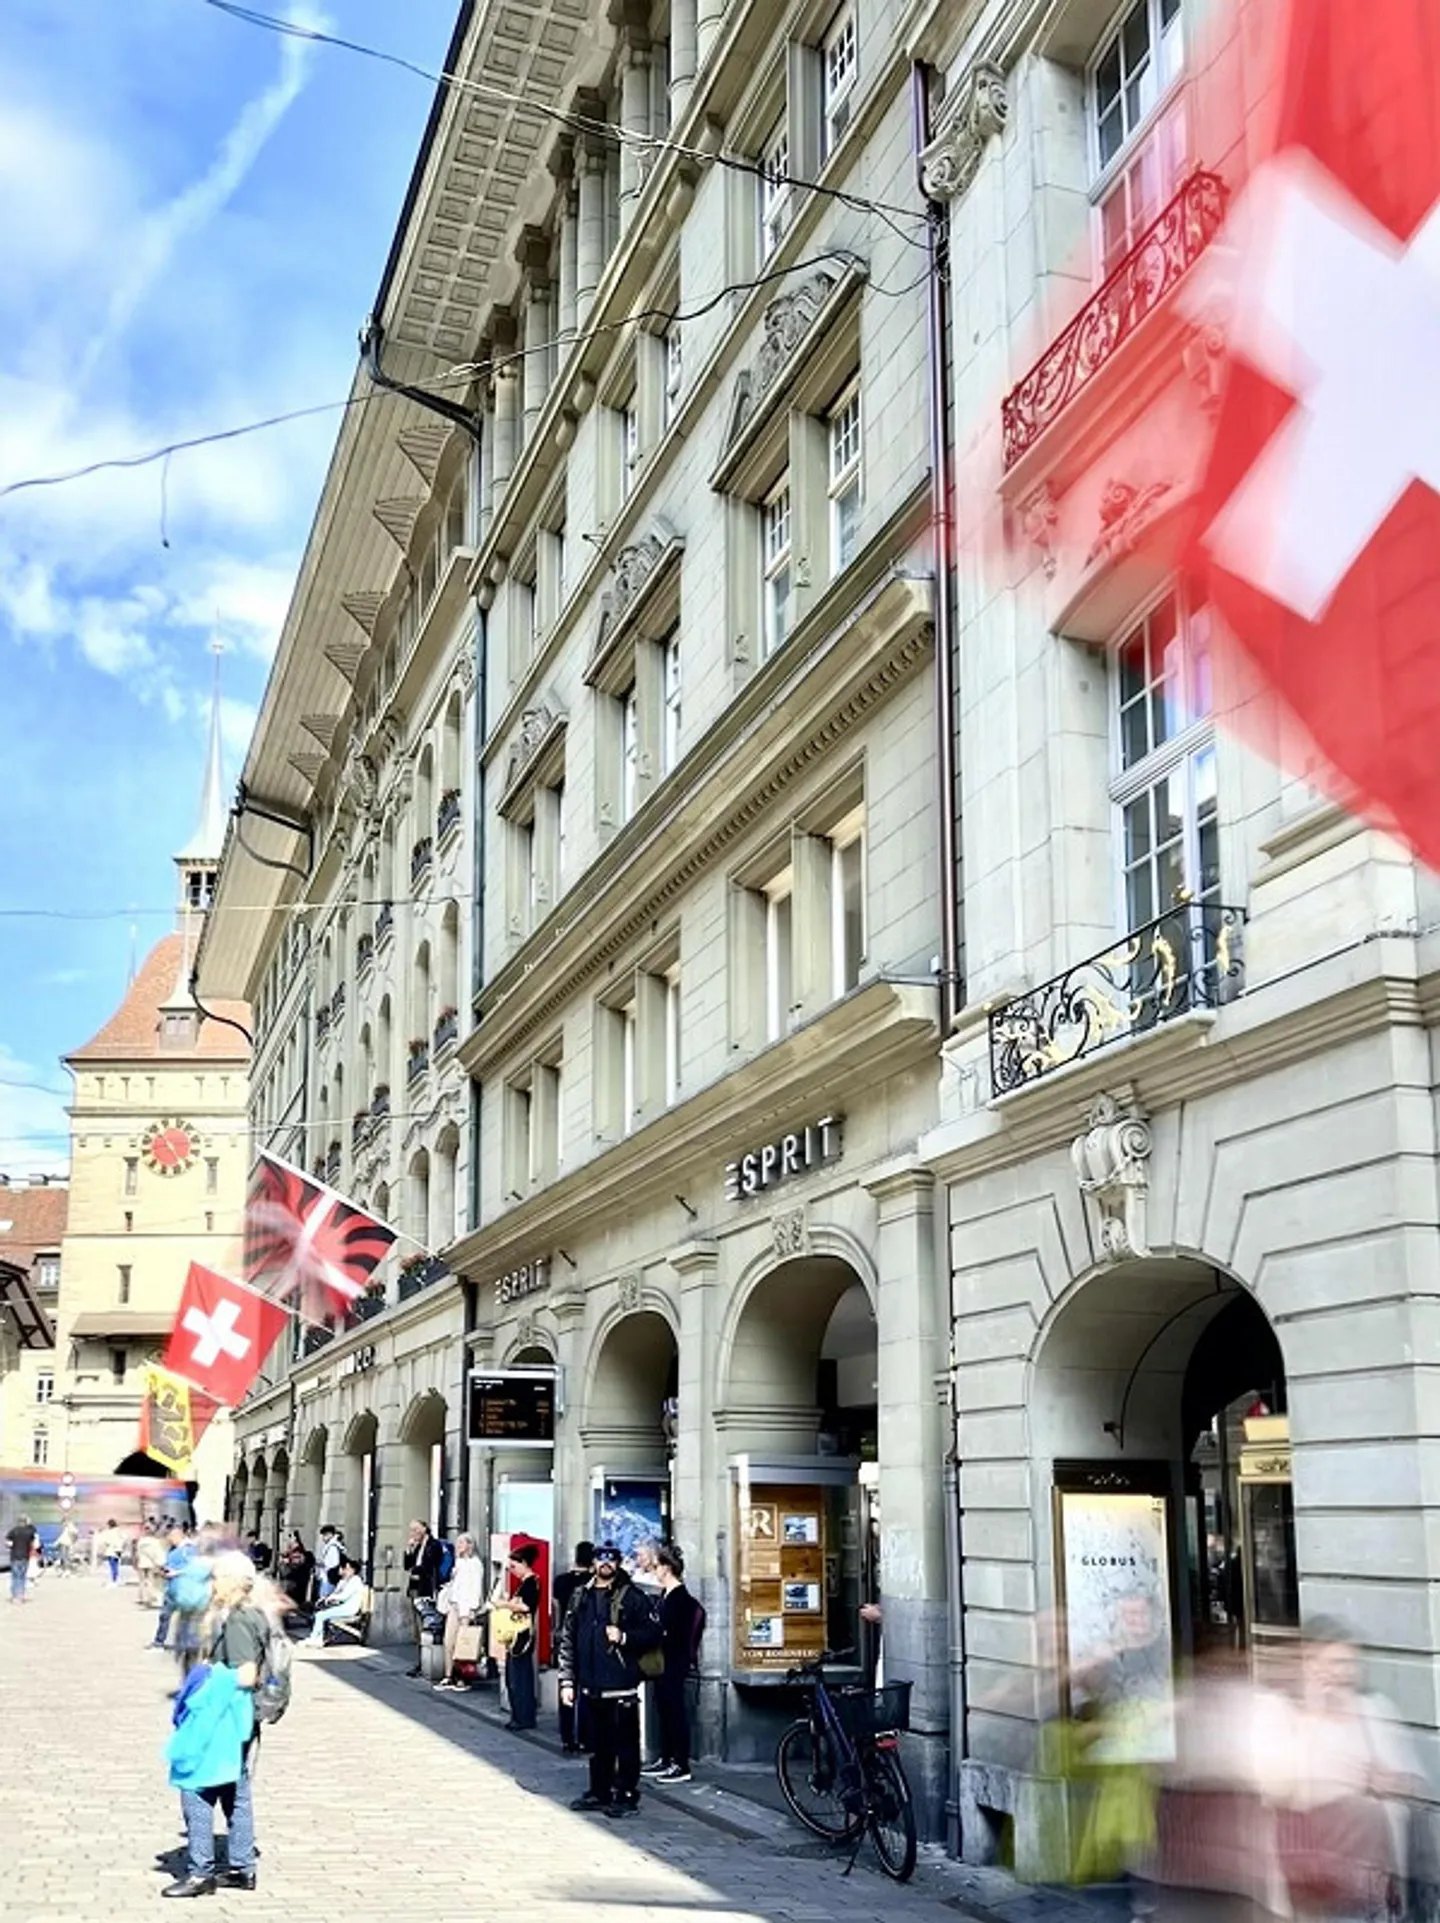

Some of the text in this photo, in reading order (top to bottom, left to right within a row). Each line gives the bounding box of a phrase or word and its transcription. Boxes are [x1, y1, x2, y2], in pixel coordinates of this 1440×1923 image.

[724, 1114, 842, 1201] ESPRIT
[494, 1258, 548, 1304] ESPRIT
[1081, 1555, 1137, 1567] GLOBUS
